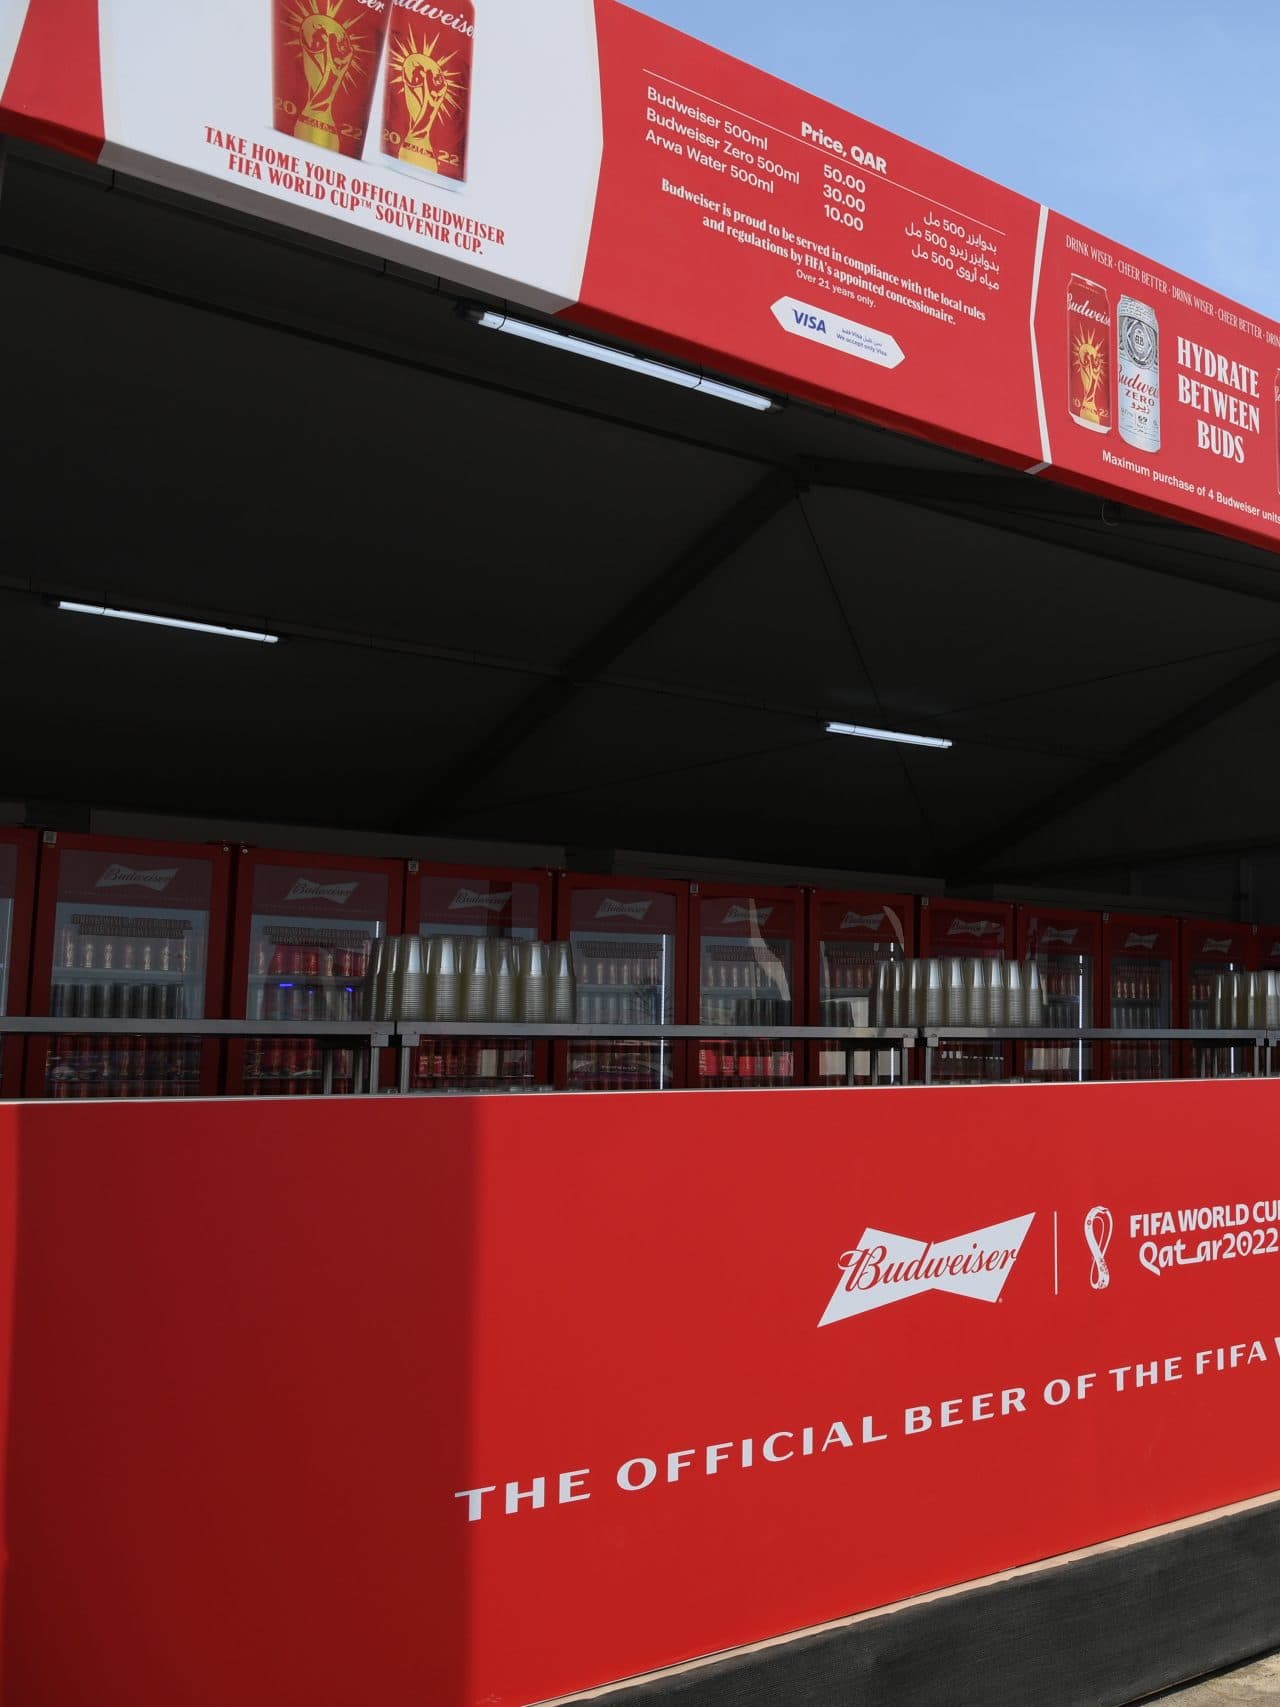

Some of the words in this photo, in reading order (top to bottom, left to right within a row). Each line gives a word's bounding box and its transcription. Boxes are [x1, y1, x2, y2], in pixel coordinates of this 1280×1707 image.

[341, 123, 363, 140] 22
[648, 86, 721, 128] Budweiser
[724, 120, 768, 150] 500ml
[383, 129, 400, 146] 20
[439, 150, 460, 166] 22
[646, 130, 682, 155] Arwa
[687, 145, 727, 173] Water
[731, 164, 774, 193] 500ml
[647, 107, 720, 149] Budweiser
[724, 141, 754, 164] Zero
[757, 156, 800, 184] 500ml
[801, 121, 846, 158] Price,
[850, 145, 887, 175] QAR
[205, 126, 247, 155] TAKE
[252, 139, 300, 171] HOME
[305, 157, 346, 191] YOUR
[351, 179, 417, 217] OFFICIAL
[422, 199, 505, 245] BUDWEISER
[823, 184, 866, 213] 30.00
[824, 164, 866, 193] 50.00
[228, 154, 262, 180] FIFA
[269, 169, 326, 201] WORLD
[375, 204, 450, 244] SOUVENIR
[454, 232, 484, 255] CUP.
[824, 204, 863, 232] 10.00
[924, 211, 940, 227] مل
[662, 177, 721, 213] Budweiser
[723, 203, 732, 217] is
[734, 210, 767, 232] proud
[769, 223, 780, 237] to
[782, 227, 795, 243] be
[796, 236, 830, 258] served
[832, 247, 842, 263] in
[844, 254, 900, 286] compliance
[900, 277, 922, 295] with
[924, 285, 940, 302] the
[941, 292, 962, 312] local
[963, 302, 986, 321] rules
[905, 222, 922, 238] مل
[925, 230, 947, 248] 500
[943, 219, 965, 238] 500
[703, 216, 724, 233] and
[727, 225, 789, 258] regulations
[790, 246, 803, 265] by
[805, 254, 832, 275] FIFA's
[833, 269, 885, 297] appointed
[886, 289, 957, 326] concessionaire.
[912, 243, 929, 259] مل
[931, 251, 953, 270] 500
[796, 269, 816, 284] Over
[818, 278, 830, 290] 21
[832, 284, 855, 300] years
[857, 293, 877, 308] only.
[1066, 234, 1089, 257] DRINK
[1090, 246, 1113, 269] WISER
[1118, 260, 1140, 281] CHEER
[1141, 270, 1168, 295] BETTER
[1172, 285, 1193, 306] DRINK
[1194, 295, 1214, 316] WISER
[1218, 308, 1238, 329] CHEER
[1239, 318, 1263, 339] BETTER
[792, 308, 826, 334] VISA
[1177, 336, 1260, 399] HYDRATE
[1125, 390, 1155, 407] ZERO
[1177, 373, 1260, 434] BETWEEN
[1197, 420, 1245, 464] BUDS
[1102, 449, 1151, 477] Maximum
[1152, 469, 1195, 493] purchase
[1197, 485, 1206, 497] of
[1208, 489, 1214, 499] 4
[1216, 492, 1260, 517] Budweiser
[1130, 1214, 1176, 1238] FIFA
[1176, 1205, 1250, 1233] WORLD
[837, 1242, 1019, 1292] Budweiser
[454, 1468, 591, 1522] THE
[616, 1415, 888, 1491] OFFICIAL
[904, 1387, 1027, 1435] BEER
[1042, 1372, 1097, 1406] OF
[1108, 1356, 1183, 1393] THE
[1196, 1341, 1268, 1376] FIFA
